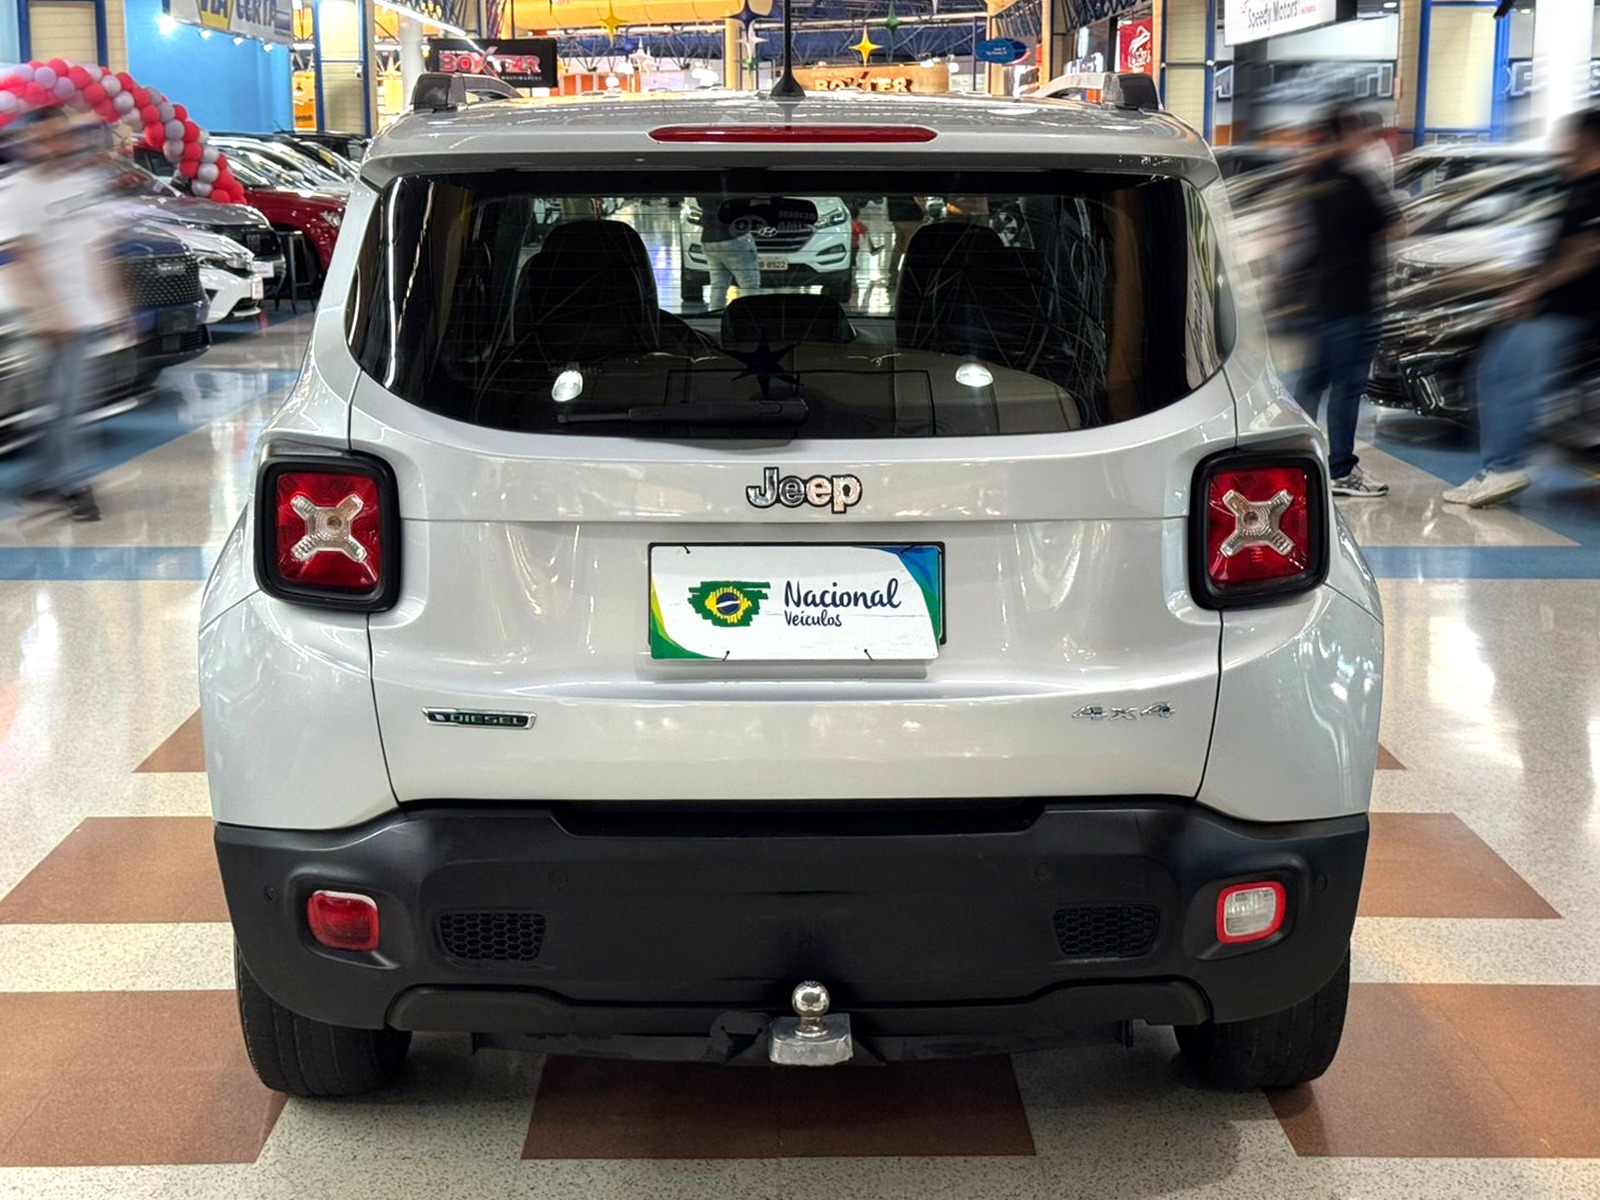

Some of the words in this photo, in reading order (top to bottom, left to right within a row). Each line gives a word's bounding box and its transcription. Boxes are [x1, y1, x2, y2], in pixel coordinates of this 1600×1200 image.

[1248, 4, 1272, 34] Speedy
[1273, 0, 1298, 21] Motors
[746, 466, 863, 514] Jeep
[784, 577, 902, 609] Nacional
[784, 610, 842, 627] Veículos
[450, 713, 525, 726] DIESEL
